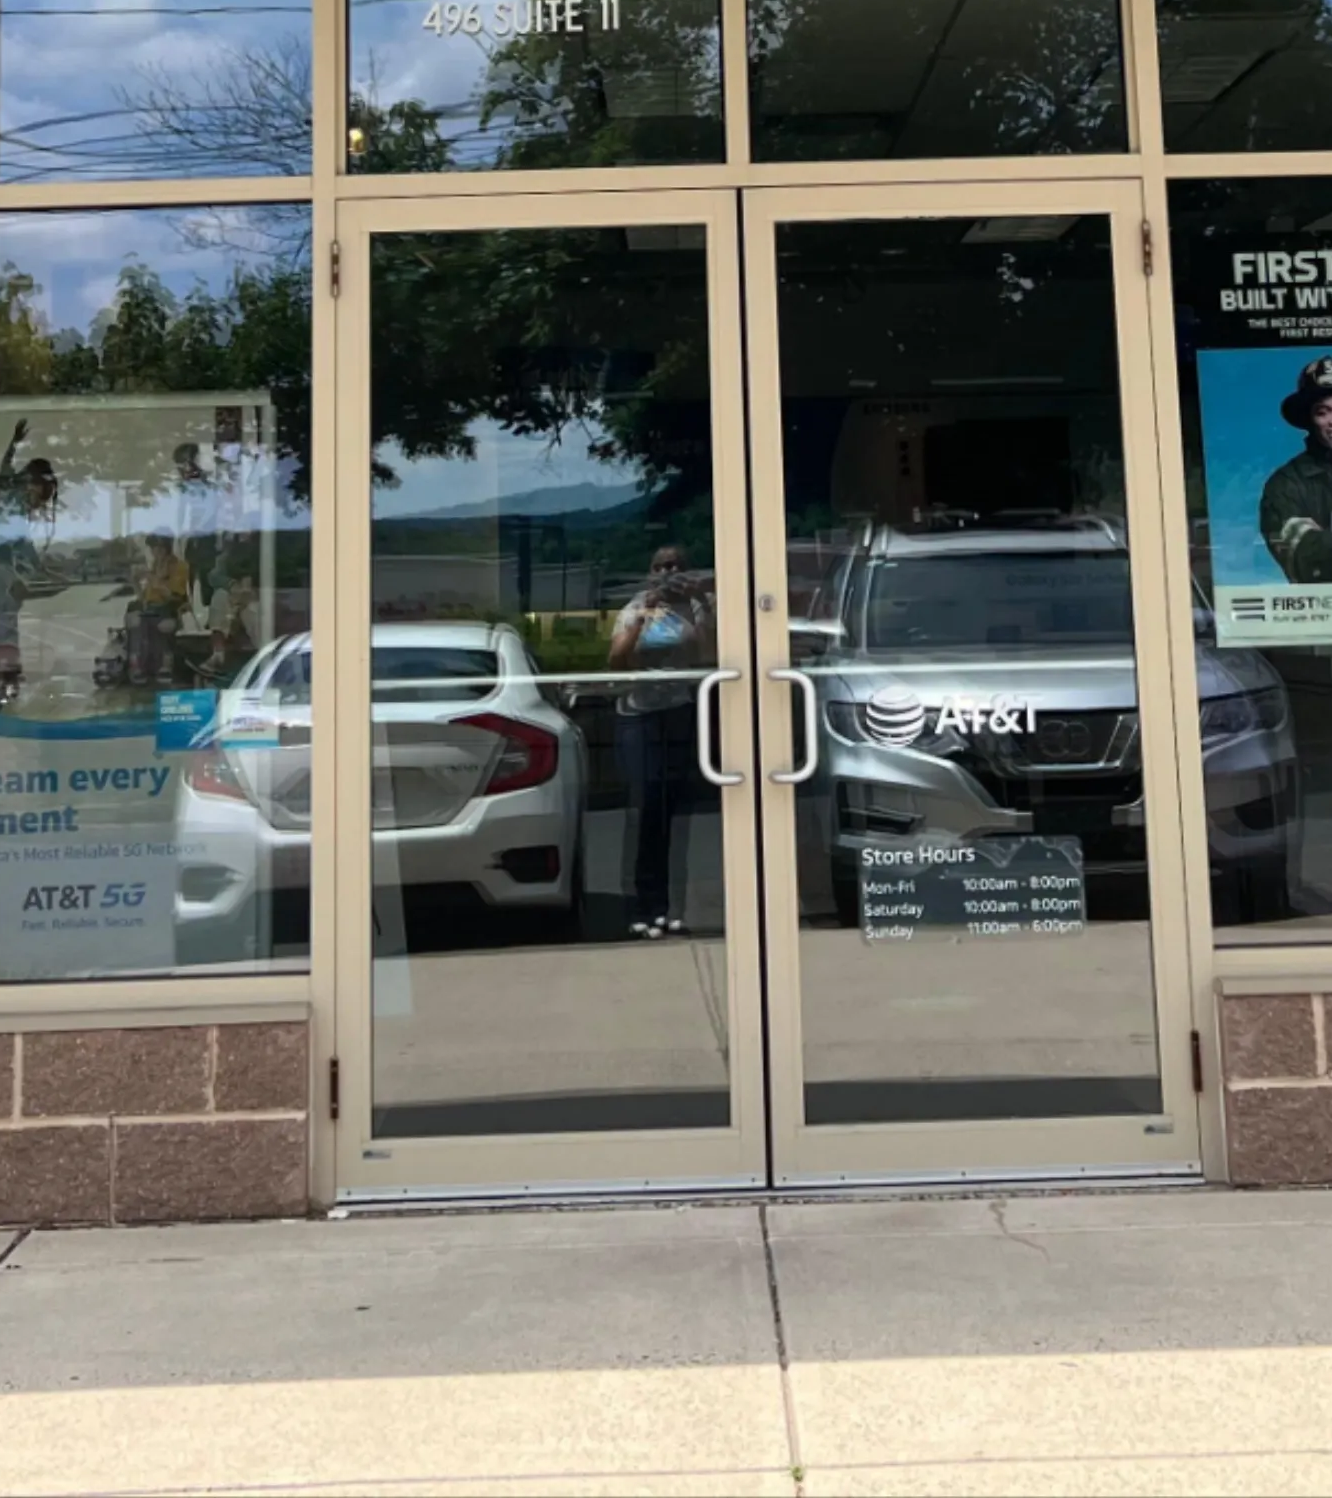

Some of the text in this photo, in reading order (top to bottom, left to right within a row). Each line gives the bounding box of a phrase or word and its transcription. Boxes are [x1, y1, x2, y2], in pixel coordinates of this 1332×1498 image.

[422, 2, 483, 35] 496
[1219, 288, 1287, 312] BUILT
[1271, 317, 1297, 328] BEST
[1279, 326, 1308, 338] FIRST
[934, 693, 1043, 735] AT&T
[69, 765, 171, 797] every
[23, 847, 61, 861] Most
[122, 843, 143, 858] 5G
[862, 845, 976, 867] Store Hours
[863, 880, 916, 896] Mon-Fri
[962, 877, 1017, 892] 10:00am
[1030, 875, 1081, 893] 8:00pm
[21, 882, 147, 913] AT&T 5G
[864, 902, 925, 919] Saturday
[963, 899, 1019, 914] 10:00am
[1031, 897, 1082, 914] 8:00pm
[865, 924, 914, 941] Sunday
[967, 921, 1021, 936] 11:00am
[1033, 919, 1083, 936] 6:00pm
